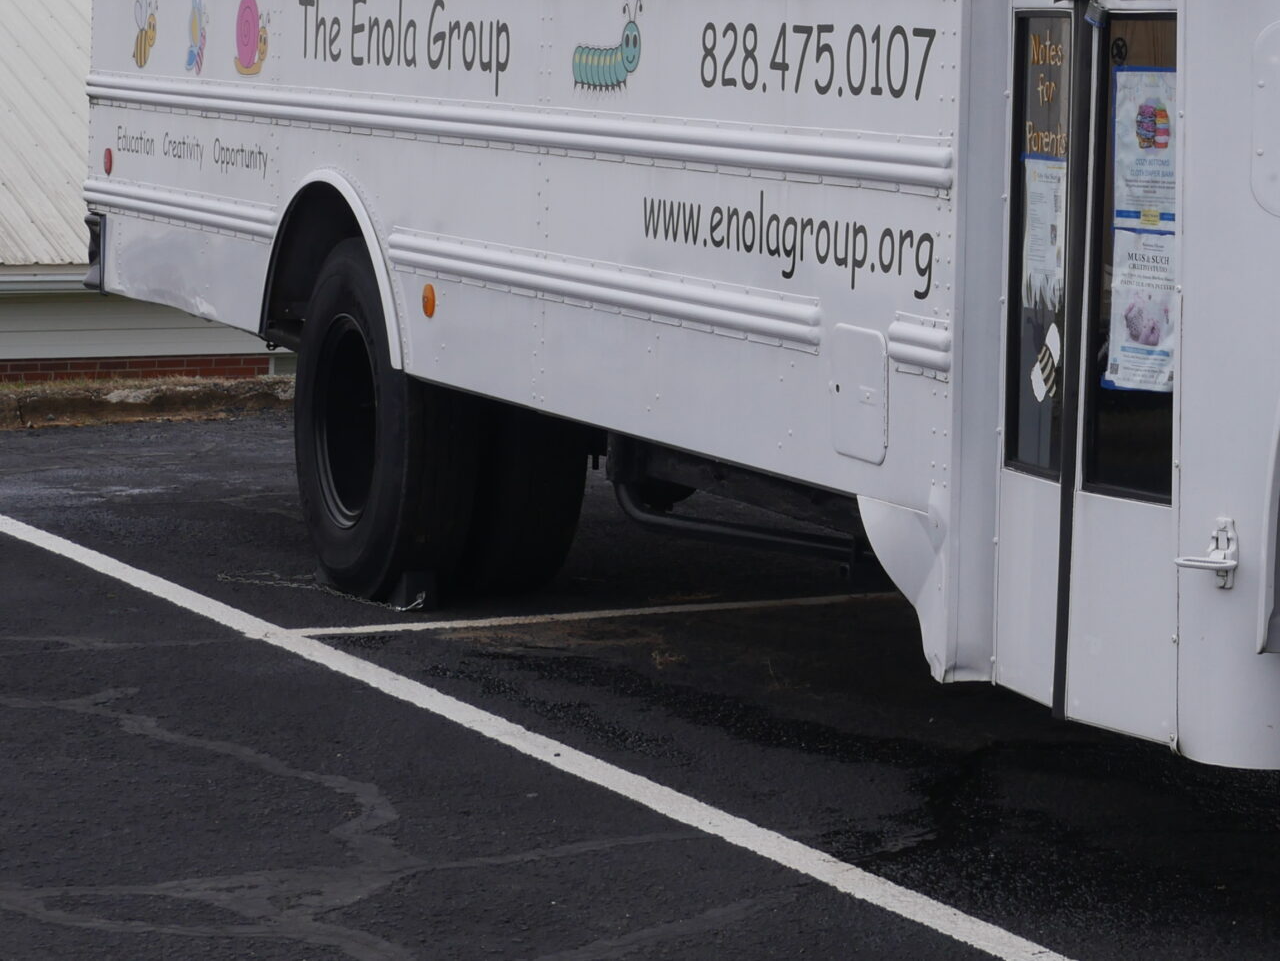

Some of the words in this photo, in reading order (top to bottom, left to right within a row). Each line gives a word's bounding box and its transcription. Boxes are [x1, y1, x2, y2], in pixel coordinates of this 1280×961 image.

[700, 22, 937, 101] 828.475.0107
[1030, 29, 1064, 67] Notes
[1036, 72, 1056, 108] for
[116, 125, 155, 156] Education
[162, 132, 204, 171] Creativity
[213, 137, 269, 178] Opportunity
[1025, 120, 1068, 158] Parents
[643, 190, 935, 300] www.enolagroup.org
